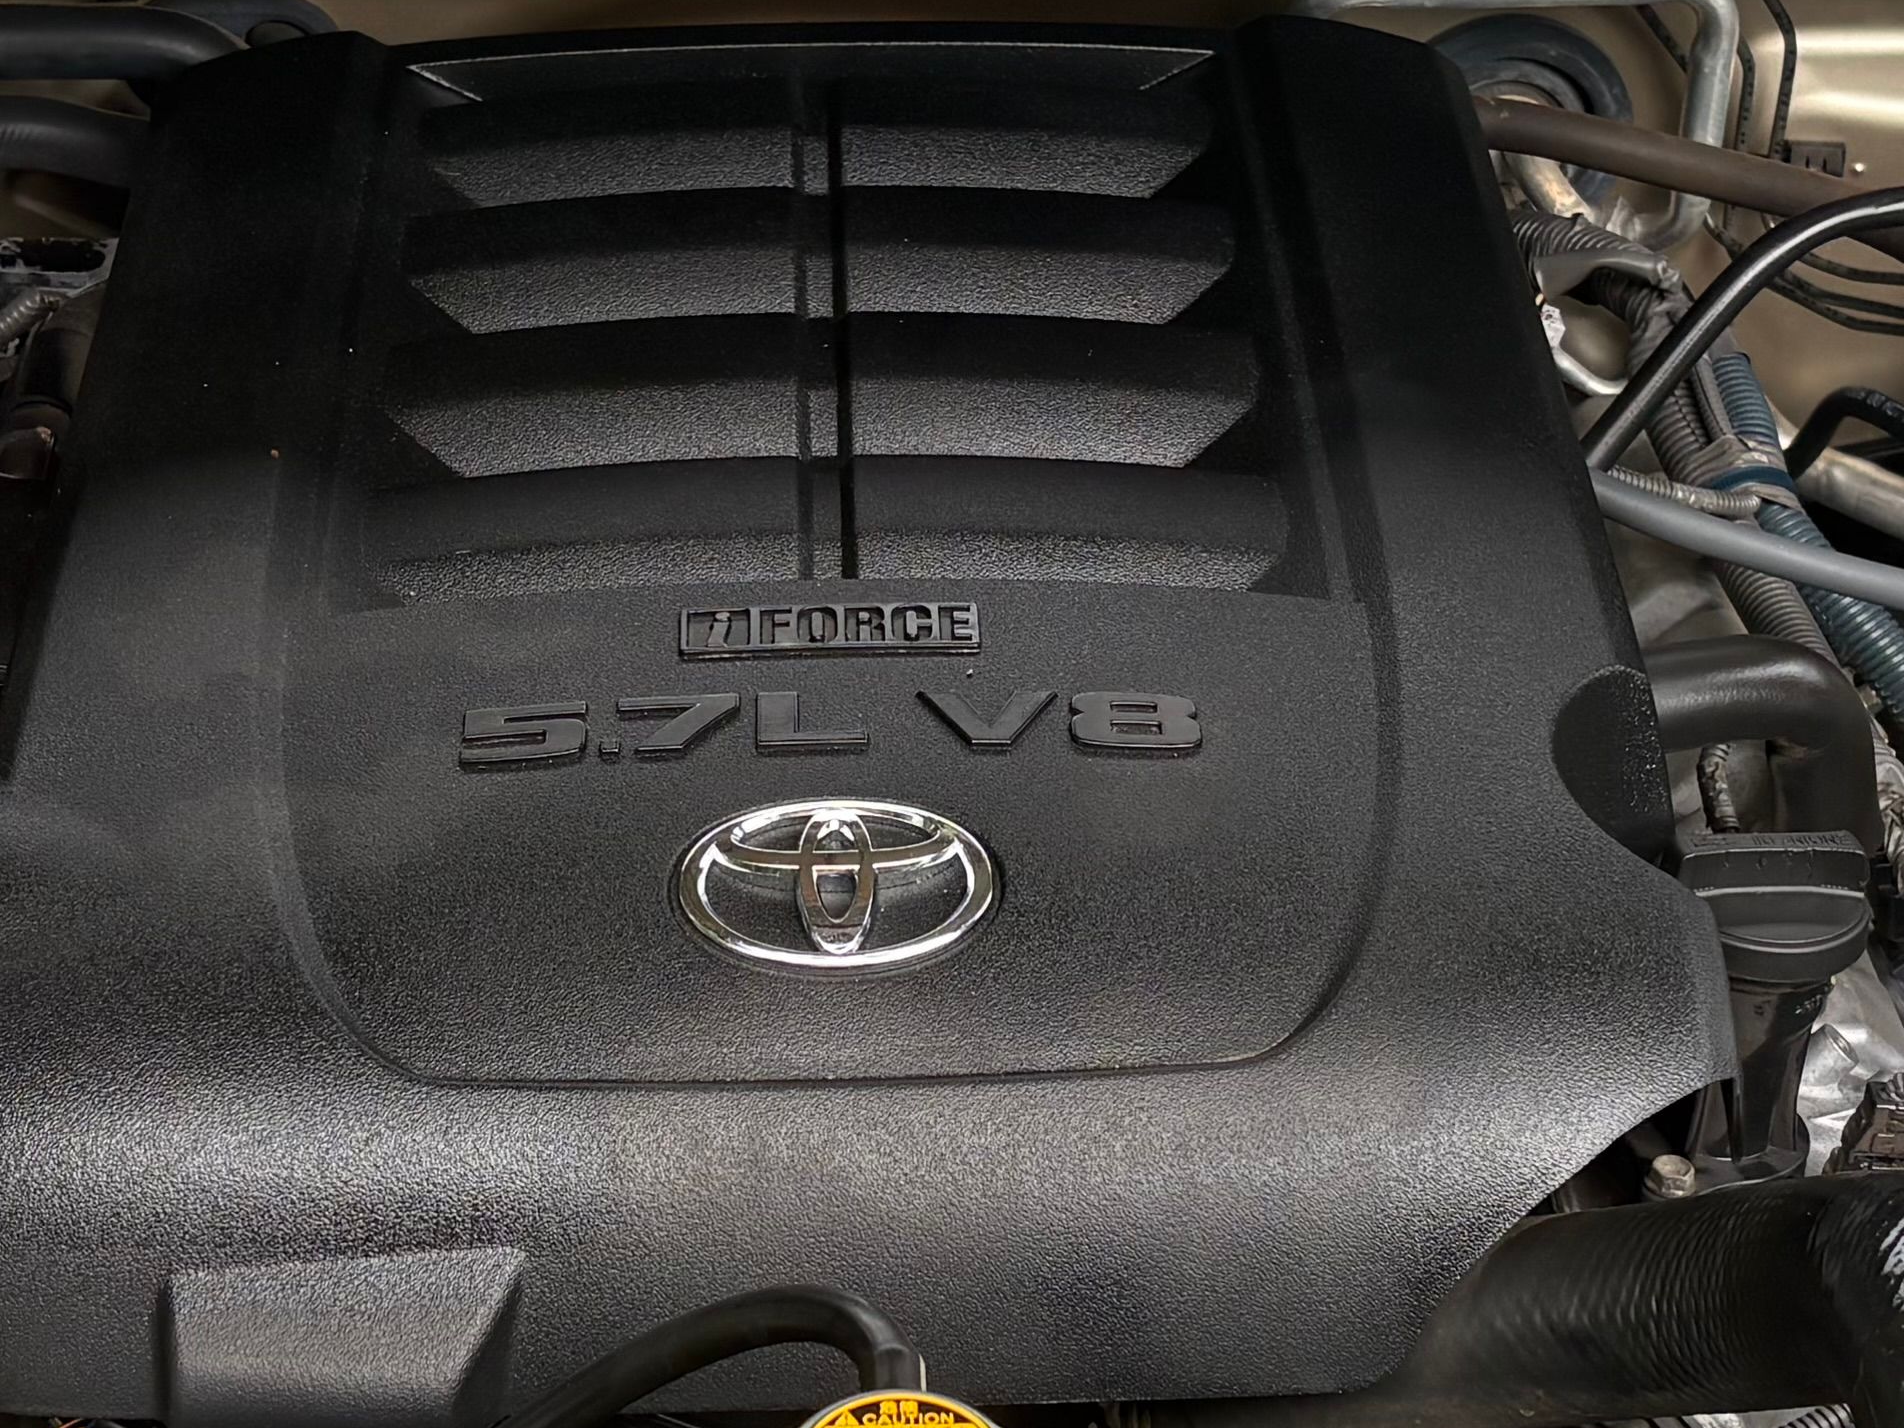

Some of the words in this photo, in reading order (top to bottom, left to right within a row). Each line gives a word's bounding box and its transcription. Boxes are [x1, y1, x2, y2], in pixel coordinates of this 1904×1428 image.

[460, 692, 869, 771] 5.7L
[916, 690, 1202, 753] V8
[862, 1411, 955, 1425] CAUTION
